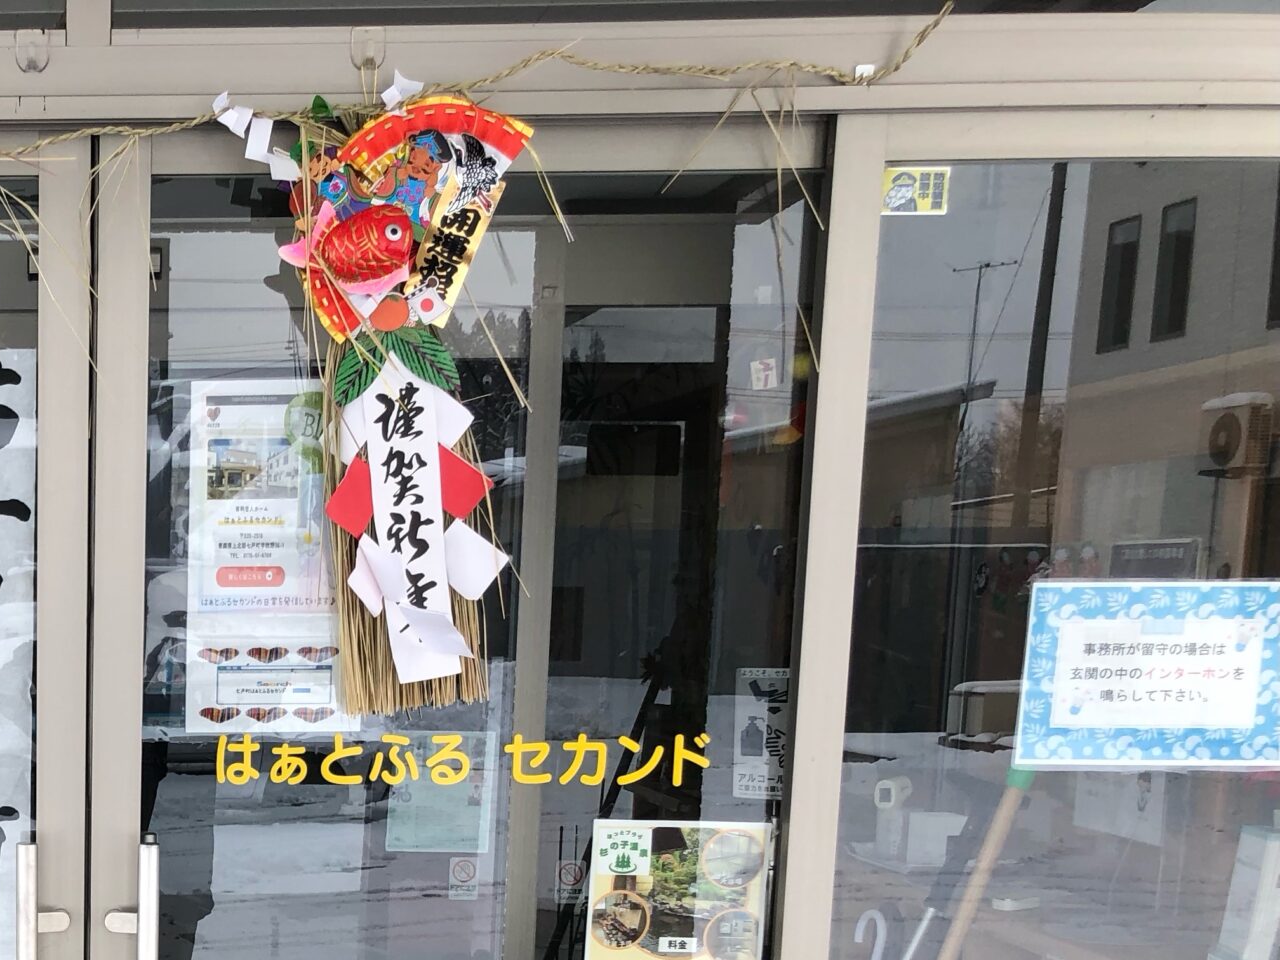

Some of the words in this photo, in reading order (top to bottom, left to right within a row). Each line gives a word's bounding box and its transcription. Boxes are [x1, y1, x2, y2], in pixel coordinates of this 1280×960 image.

[419, 208, 482, 302] 開運招
[1083, 642, 1226, 656] 事務所が留守の場合は
[1070, 666, 1245, 681] 玄関の中のインターホンを
[1099, 689, 1209, 703] 鳴らして下さい。
[216, 733, 472, 786] はぁとふる
[504, 733, 712, 787] セカンド
[667, 940, 688, 950] 料金
